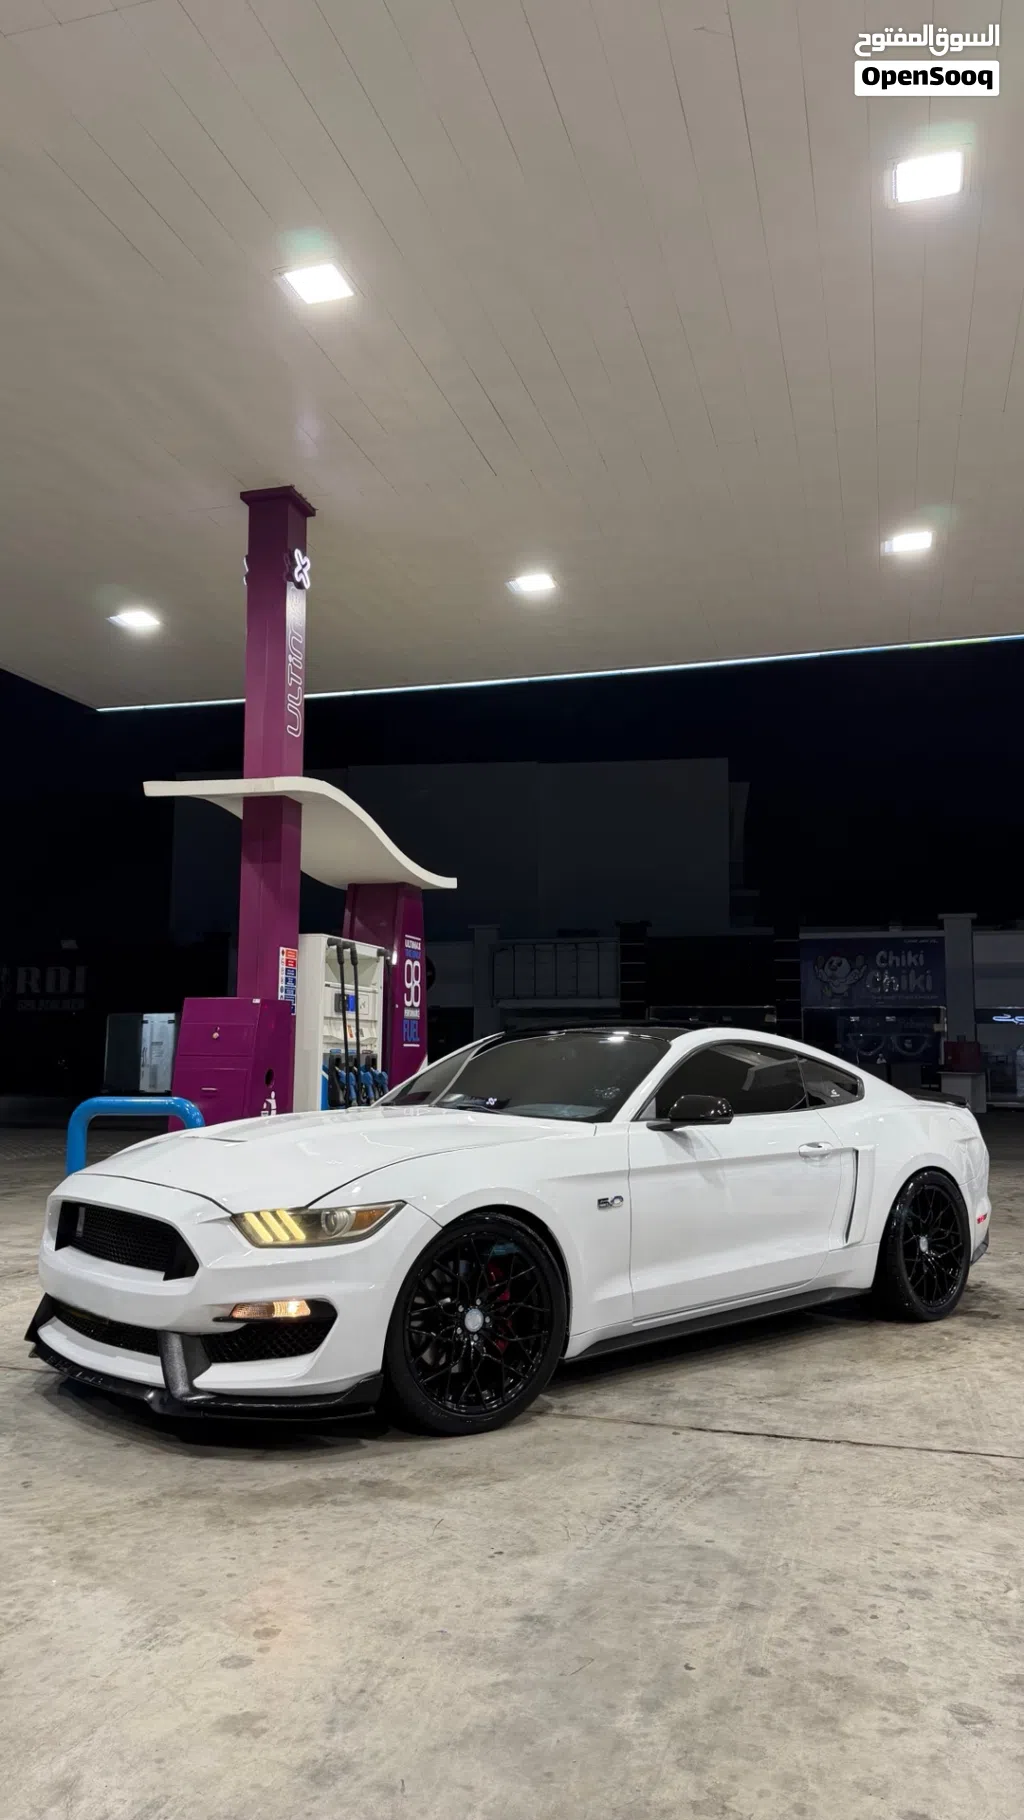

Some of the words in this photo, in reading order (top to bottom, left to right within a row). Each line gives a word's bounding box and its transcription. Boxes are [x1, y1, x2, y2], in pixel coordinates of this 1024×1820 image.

[876, 950, 924, 968] Chiki
[404, 959, 420, 1007] 98
[866, 969, 933, 993] Chiki
[597, 1195, 624, 1210] 5.0
